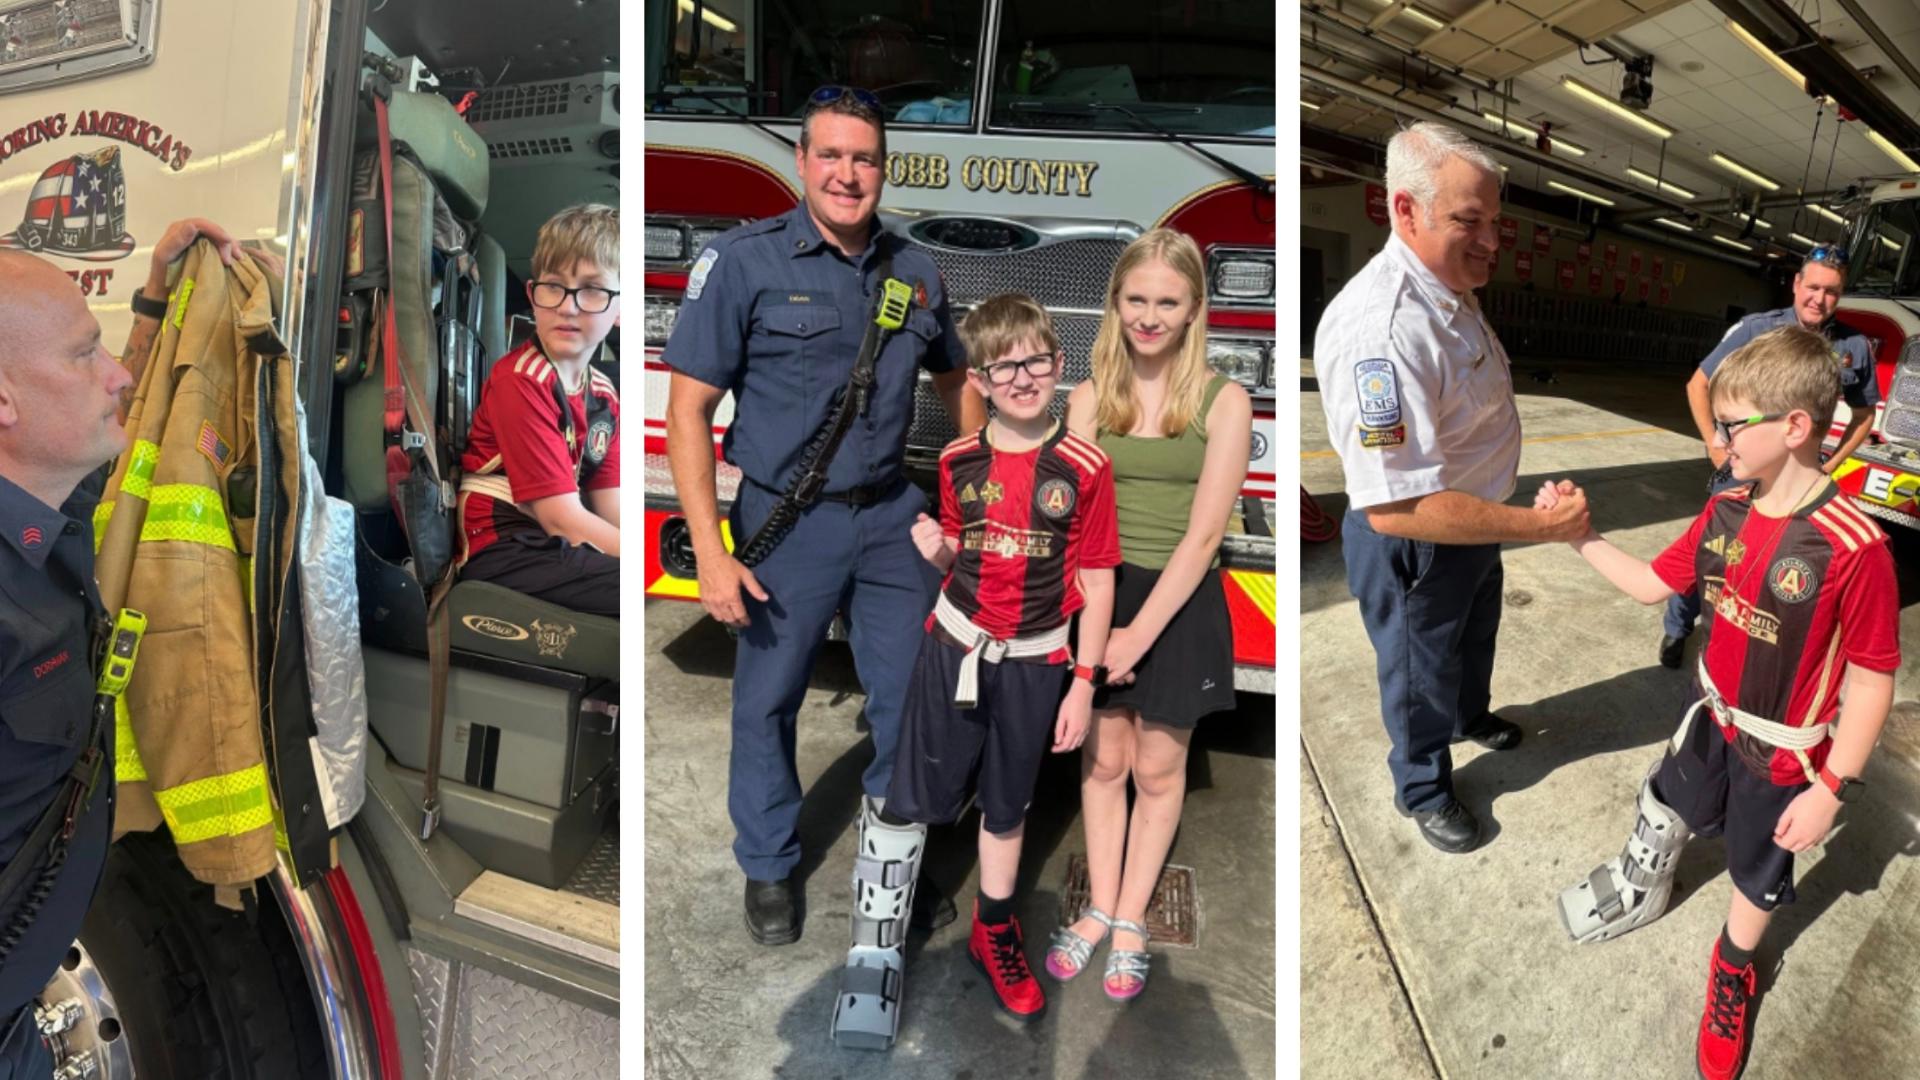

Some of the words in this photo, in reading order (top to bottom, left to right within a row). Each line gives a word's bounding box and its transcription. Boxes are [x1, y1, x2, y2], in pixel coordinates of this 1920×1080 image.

[0, 113, 68, 164] ORING
[70, 110, 193, 171] AMERICA'S
[885, 151, 949, 189] OBB
[961, 155, 1099, 197] COUNTY
[1365, 398, 1395, 411] EMS
